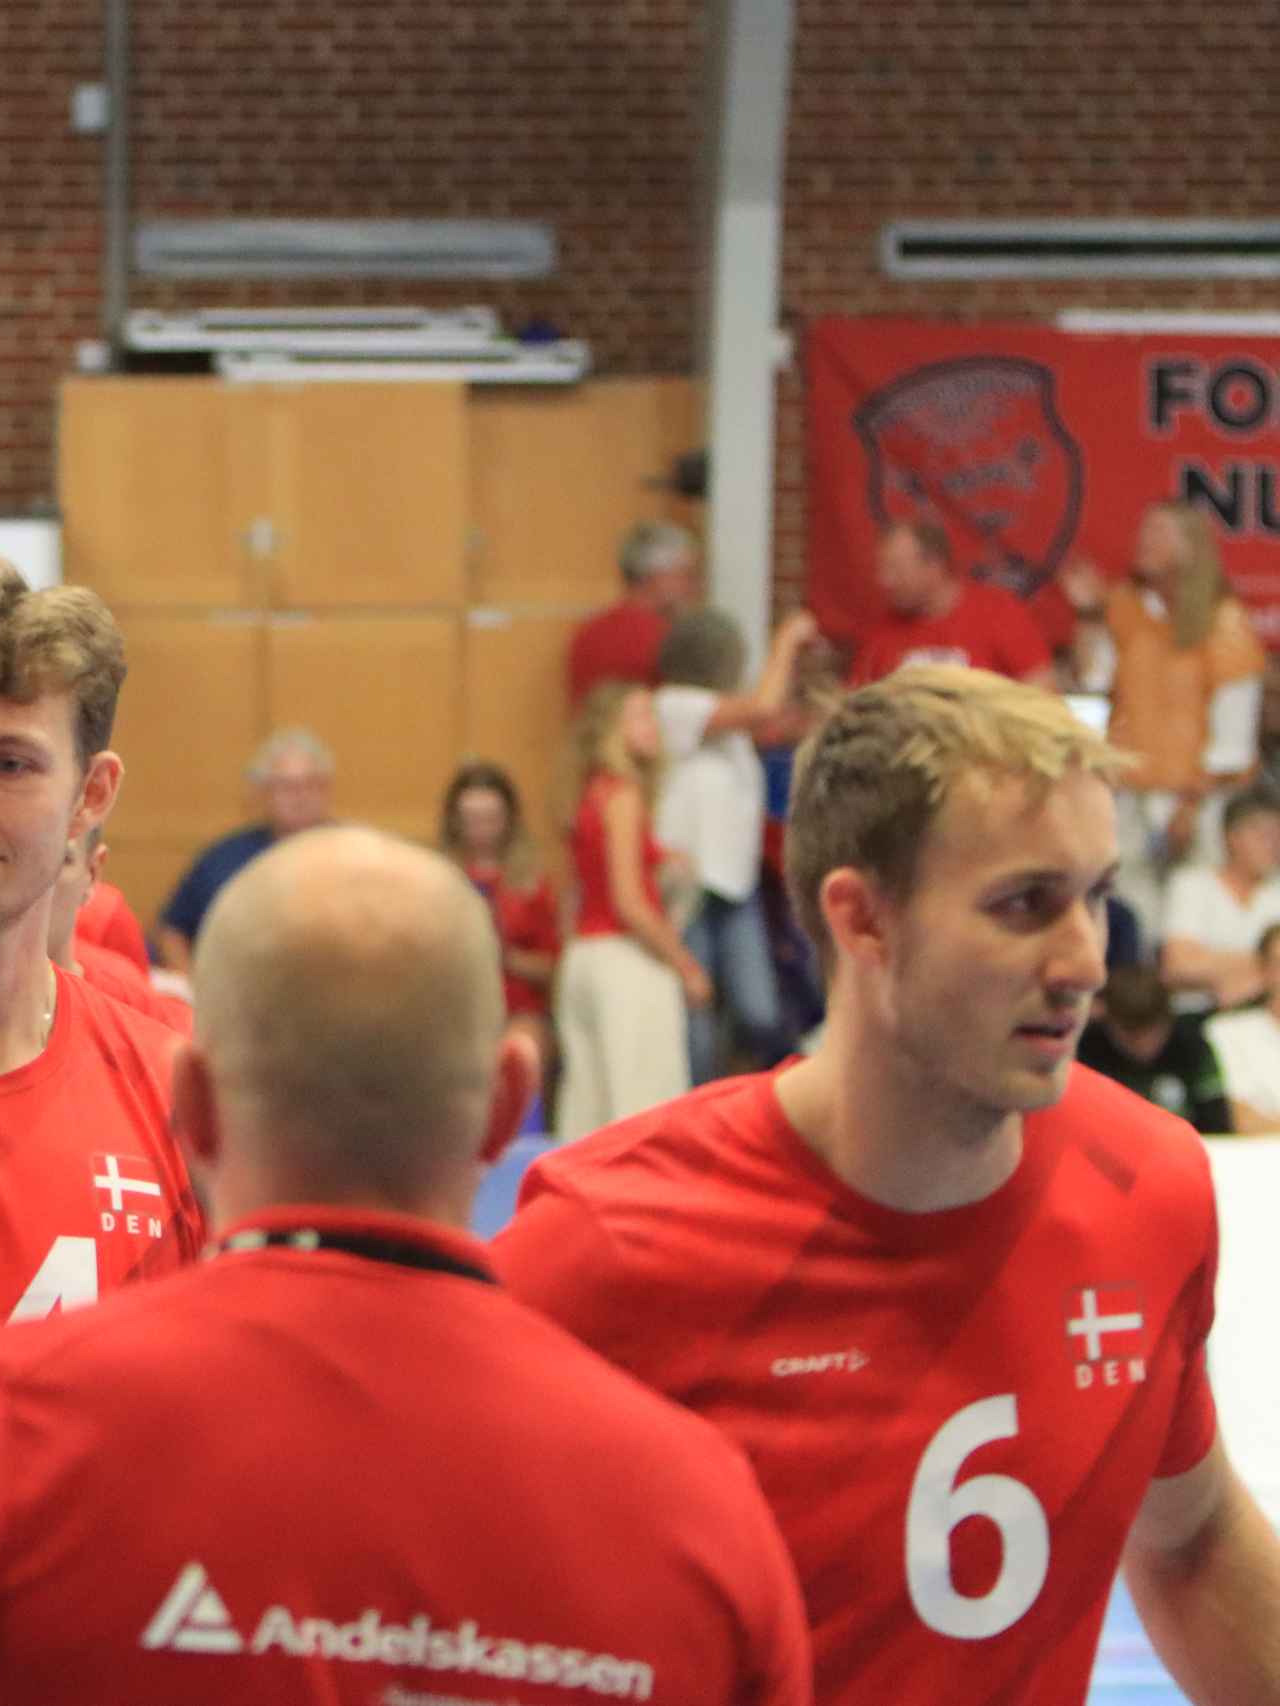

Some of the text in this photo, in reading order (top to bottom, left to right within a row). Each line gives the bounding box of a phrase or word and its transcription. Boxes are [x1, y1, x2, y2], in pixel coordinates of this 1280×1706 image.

[100, 1211, 164, 1240] DEN
[770, 1352, 848, 1377] CRAFT
[1076, 1358, 1147, 1390] DEN
[905, 1393, 1051, 1641] 6
[250, 1604, 656, 1700] Andelskassen
